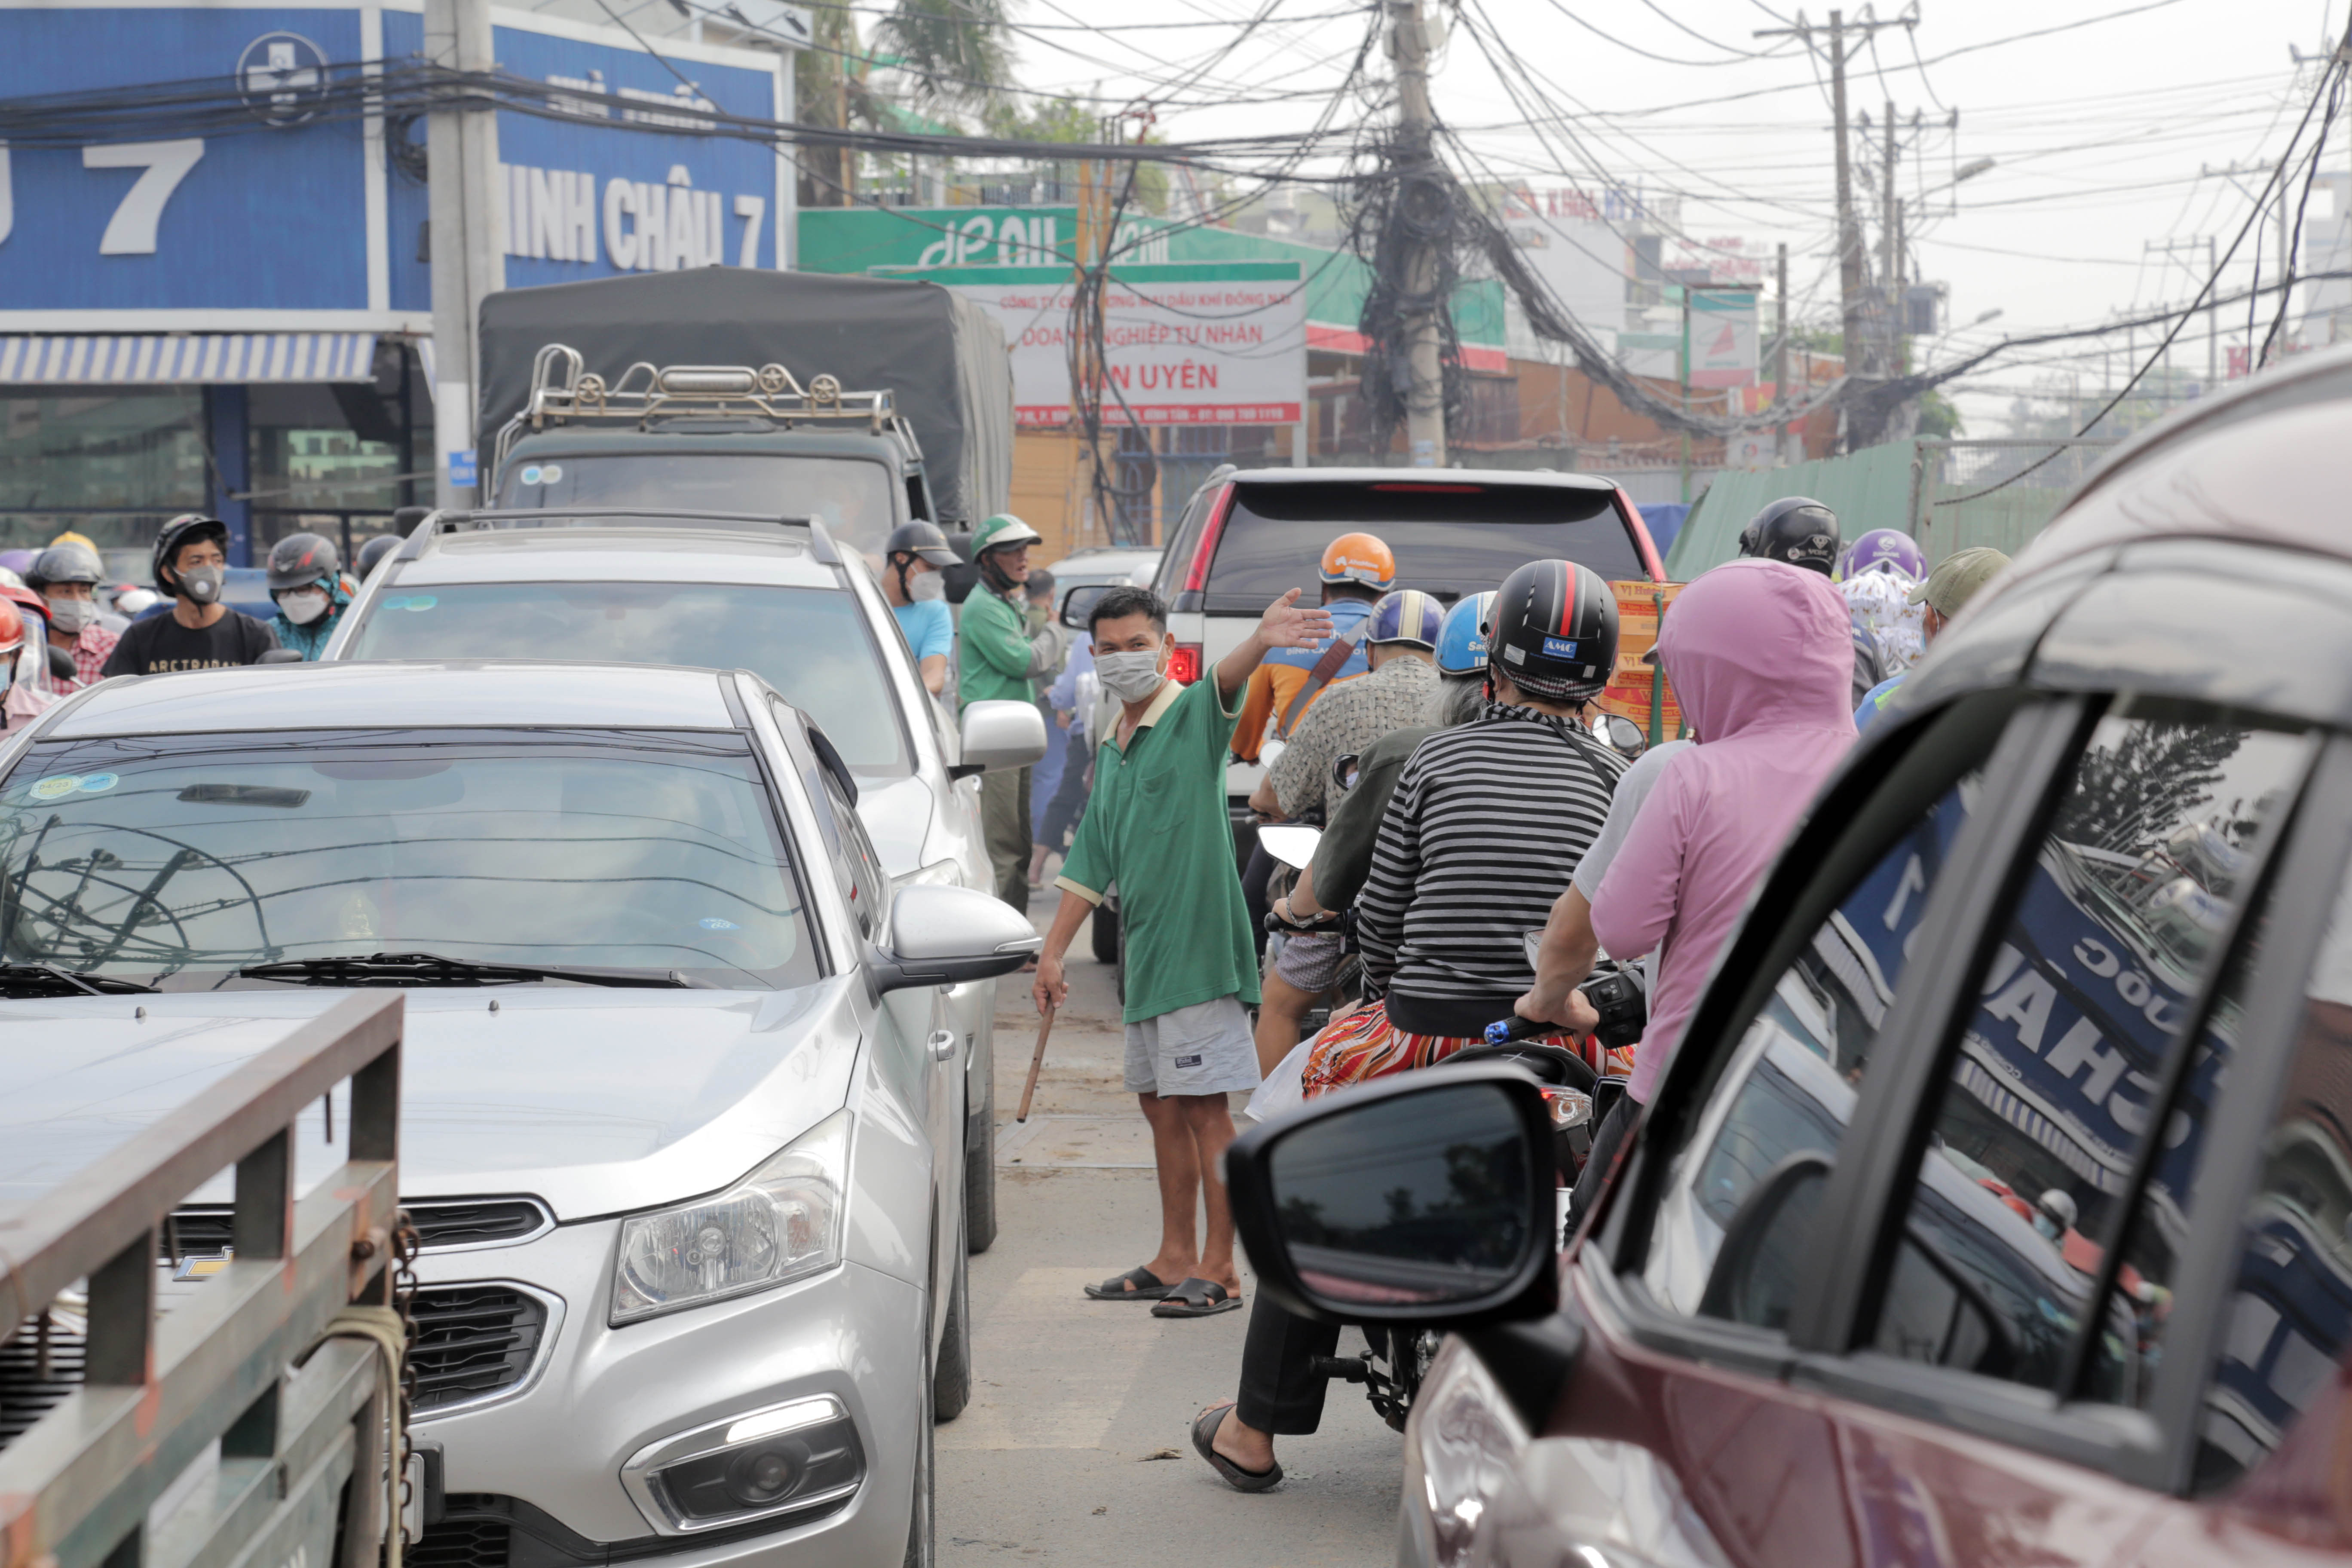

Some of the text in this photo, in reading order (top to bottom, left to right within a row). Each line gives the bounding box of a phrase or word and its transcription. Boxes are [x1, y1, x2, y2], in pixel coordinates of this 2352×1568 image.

[83, 138, 204, 254] 7
[499, 162, 765, 271] INH CHÂU 7
[1175, 323, 1202, 345] TƯ
[1206, 323, 1262, 343] NHÂN
[1140, 359, 1218, 389] UYÊN
[1545, 640, 1575, 652] AMC
